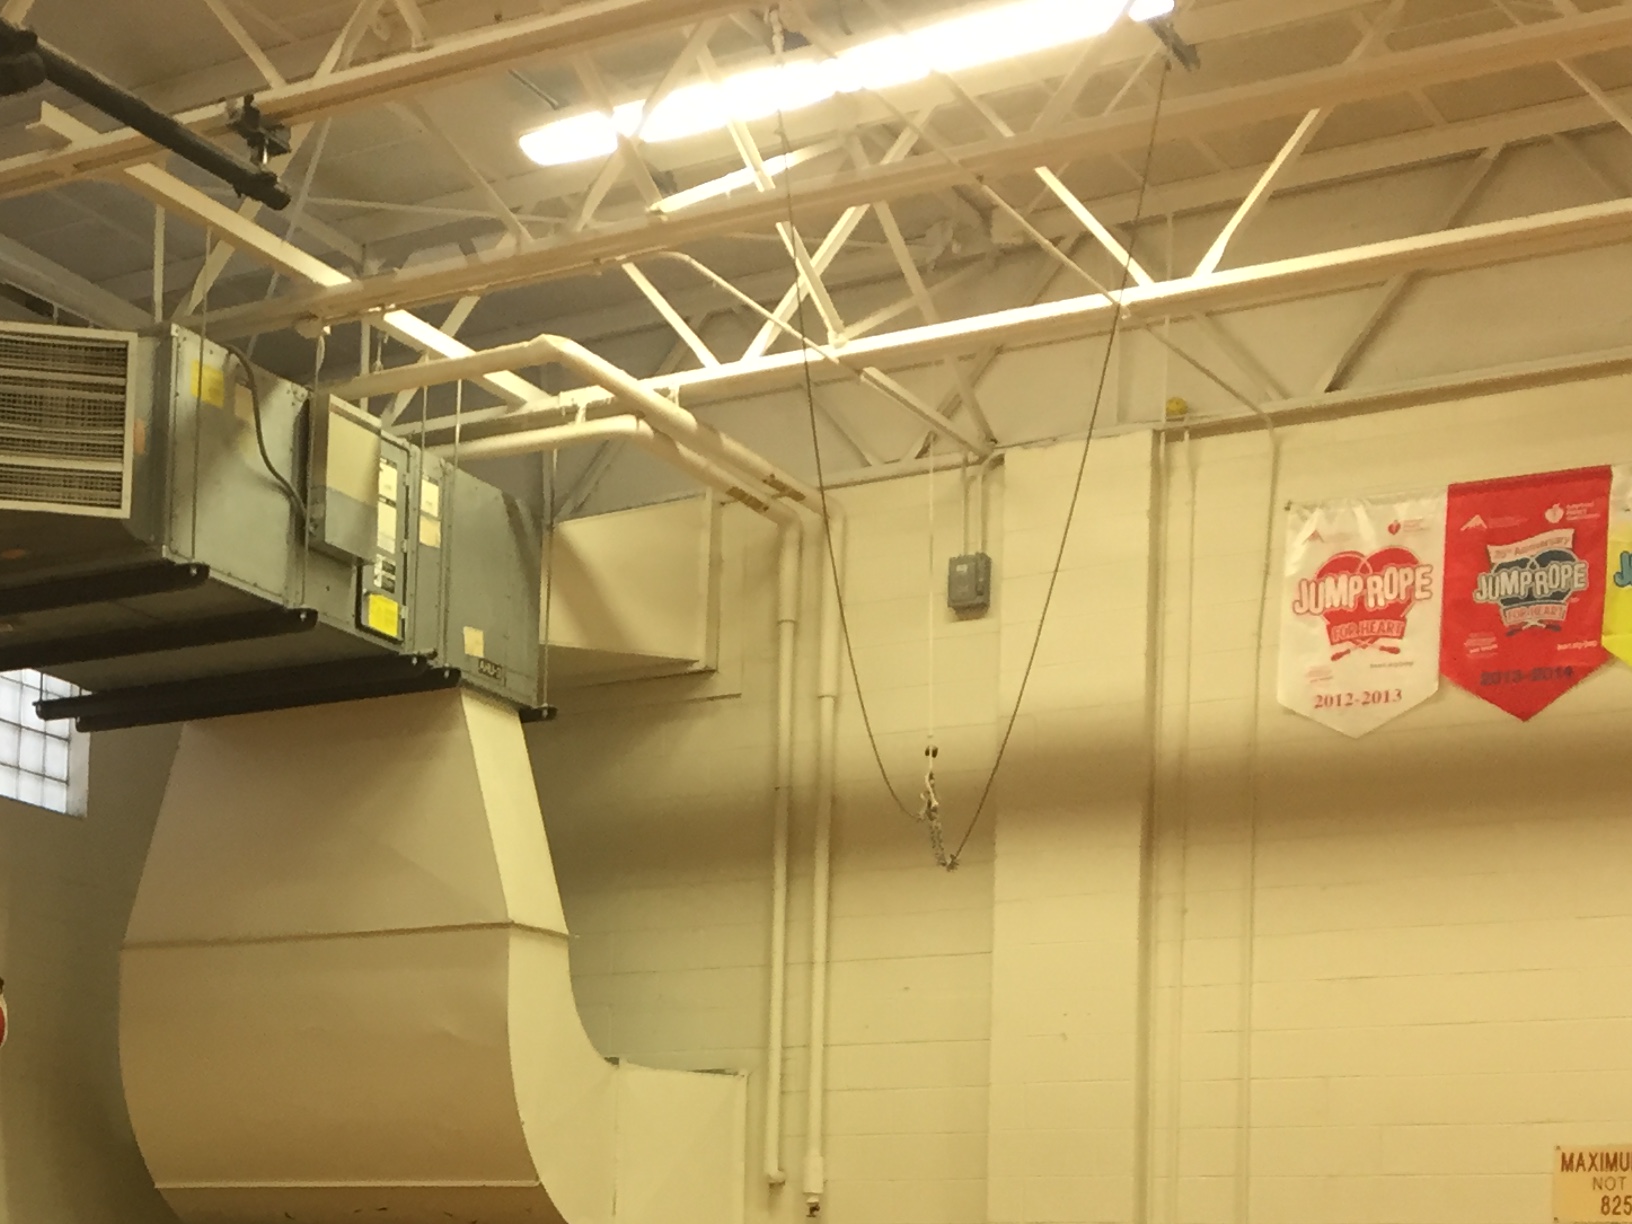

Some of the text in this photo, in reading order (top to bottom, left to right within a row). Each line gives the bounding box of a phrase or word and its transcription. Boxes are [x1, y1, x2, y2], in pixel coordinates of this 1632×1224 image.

[1293, 564, 1433, 615] JUMP ROPE
[1473, 560, 1588, 603] JUMP ROPE
[1332, 619, 1404, 641] FOR HEART
[1314, 688, 1402, 710] 2012-2013
[1561, 1152, 1632, 1172] MAXIMU
[1592, 1176, 1626, 1191] NOT
[1601, 1195, 1632, 1216] 825
